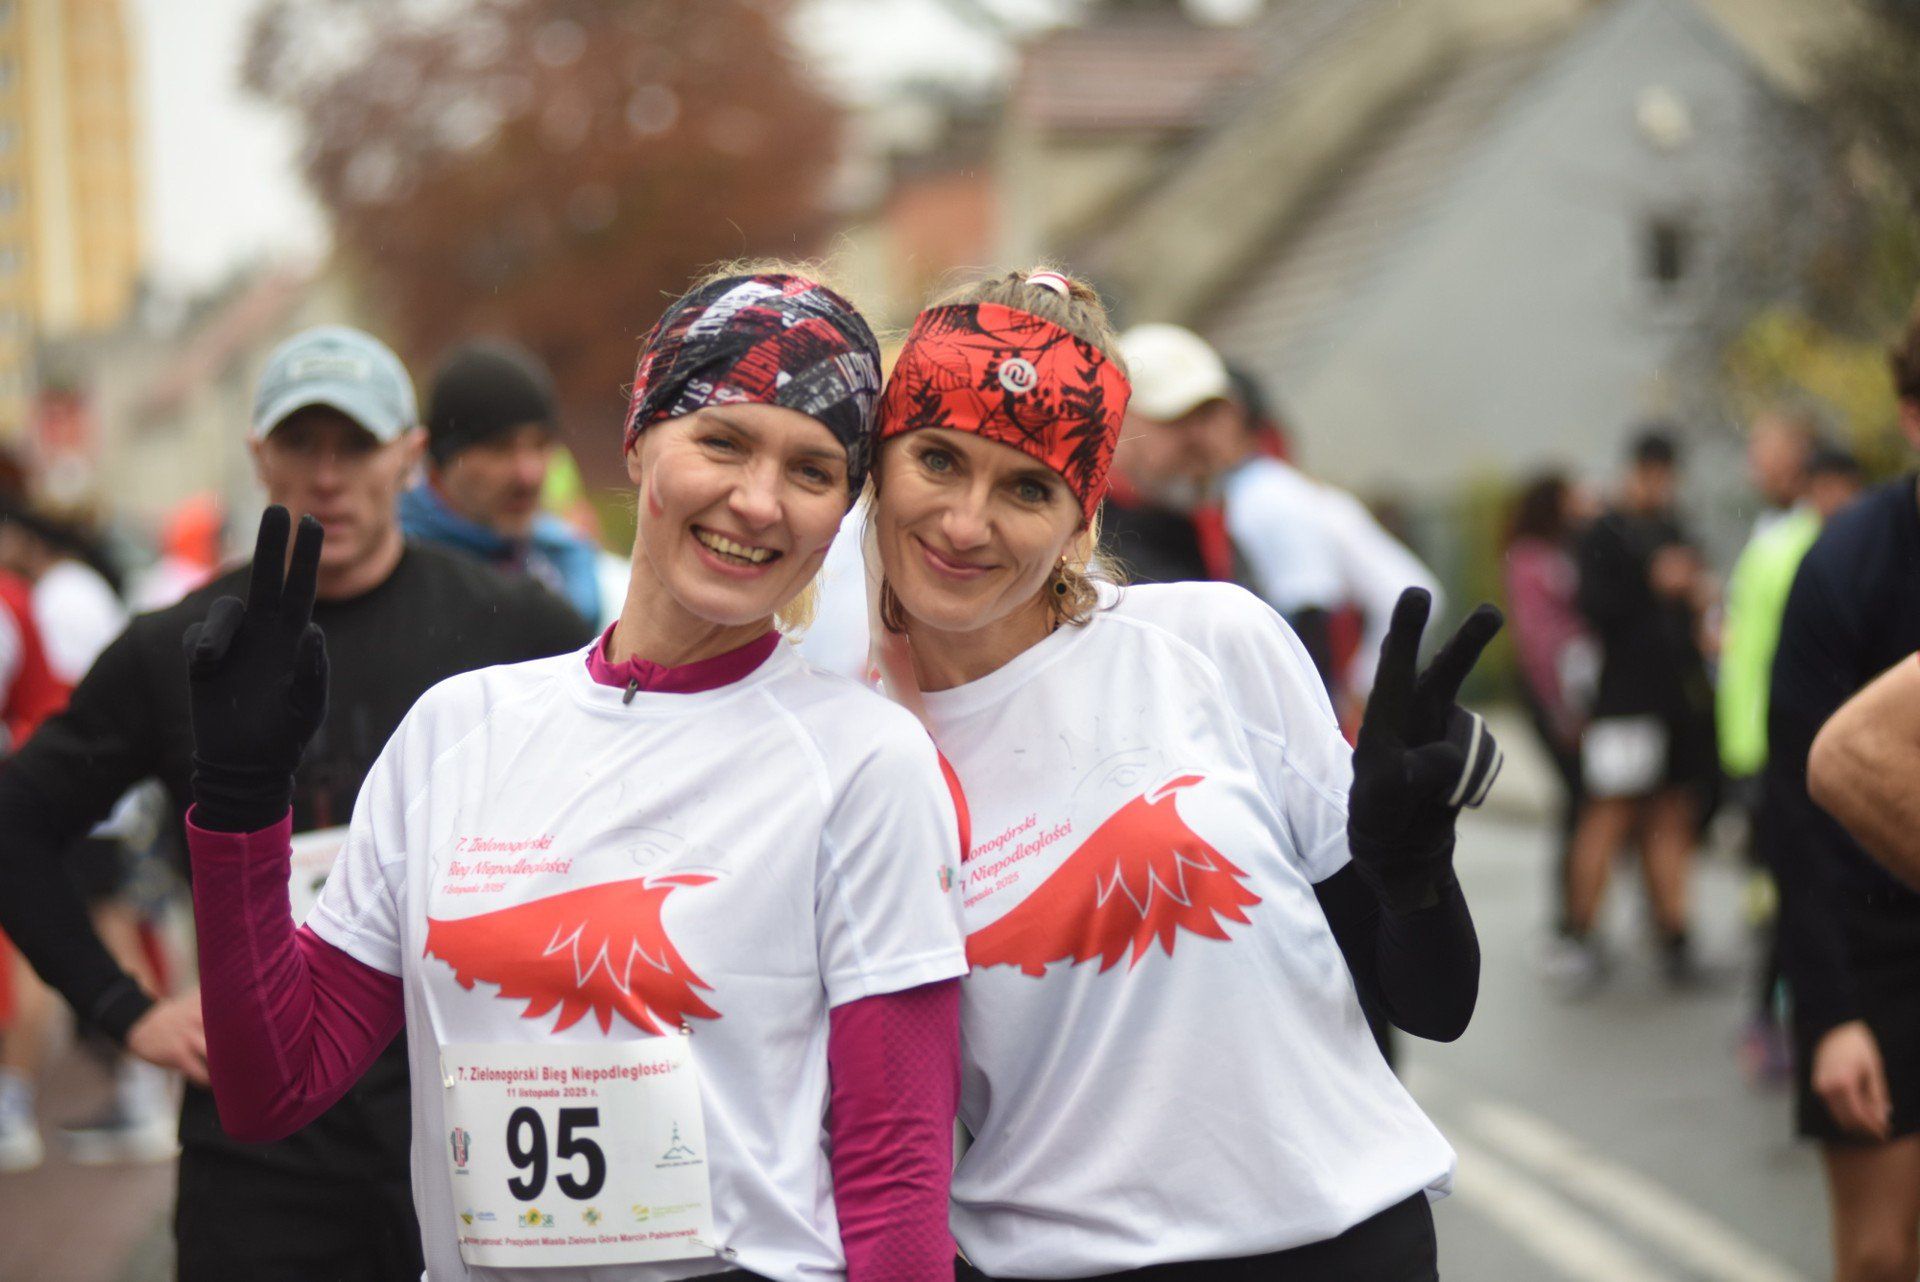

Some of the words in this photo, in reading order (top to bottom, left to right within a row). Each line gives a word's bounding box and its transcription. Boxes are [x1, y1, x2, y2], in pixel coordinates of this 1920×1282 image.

[967, 813, 1037, 861] onogórski
[458, 1067, 467, 1081] 7.
[542, 1066, 567, 1084] Bieg
[506, 1088, 516, 1097] 11
[518, 1087, 560, 1099] listopada
[563, 1086, 587, 1097] 2025
[506, 1106, 606, 1202] 95
[620, 1232, 648, 1243] Marcin
